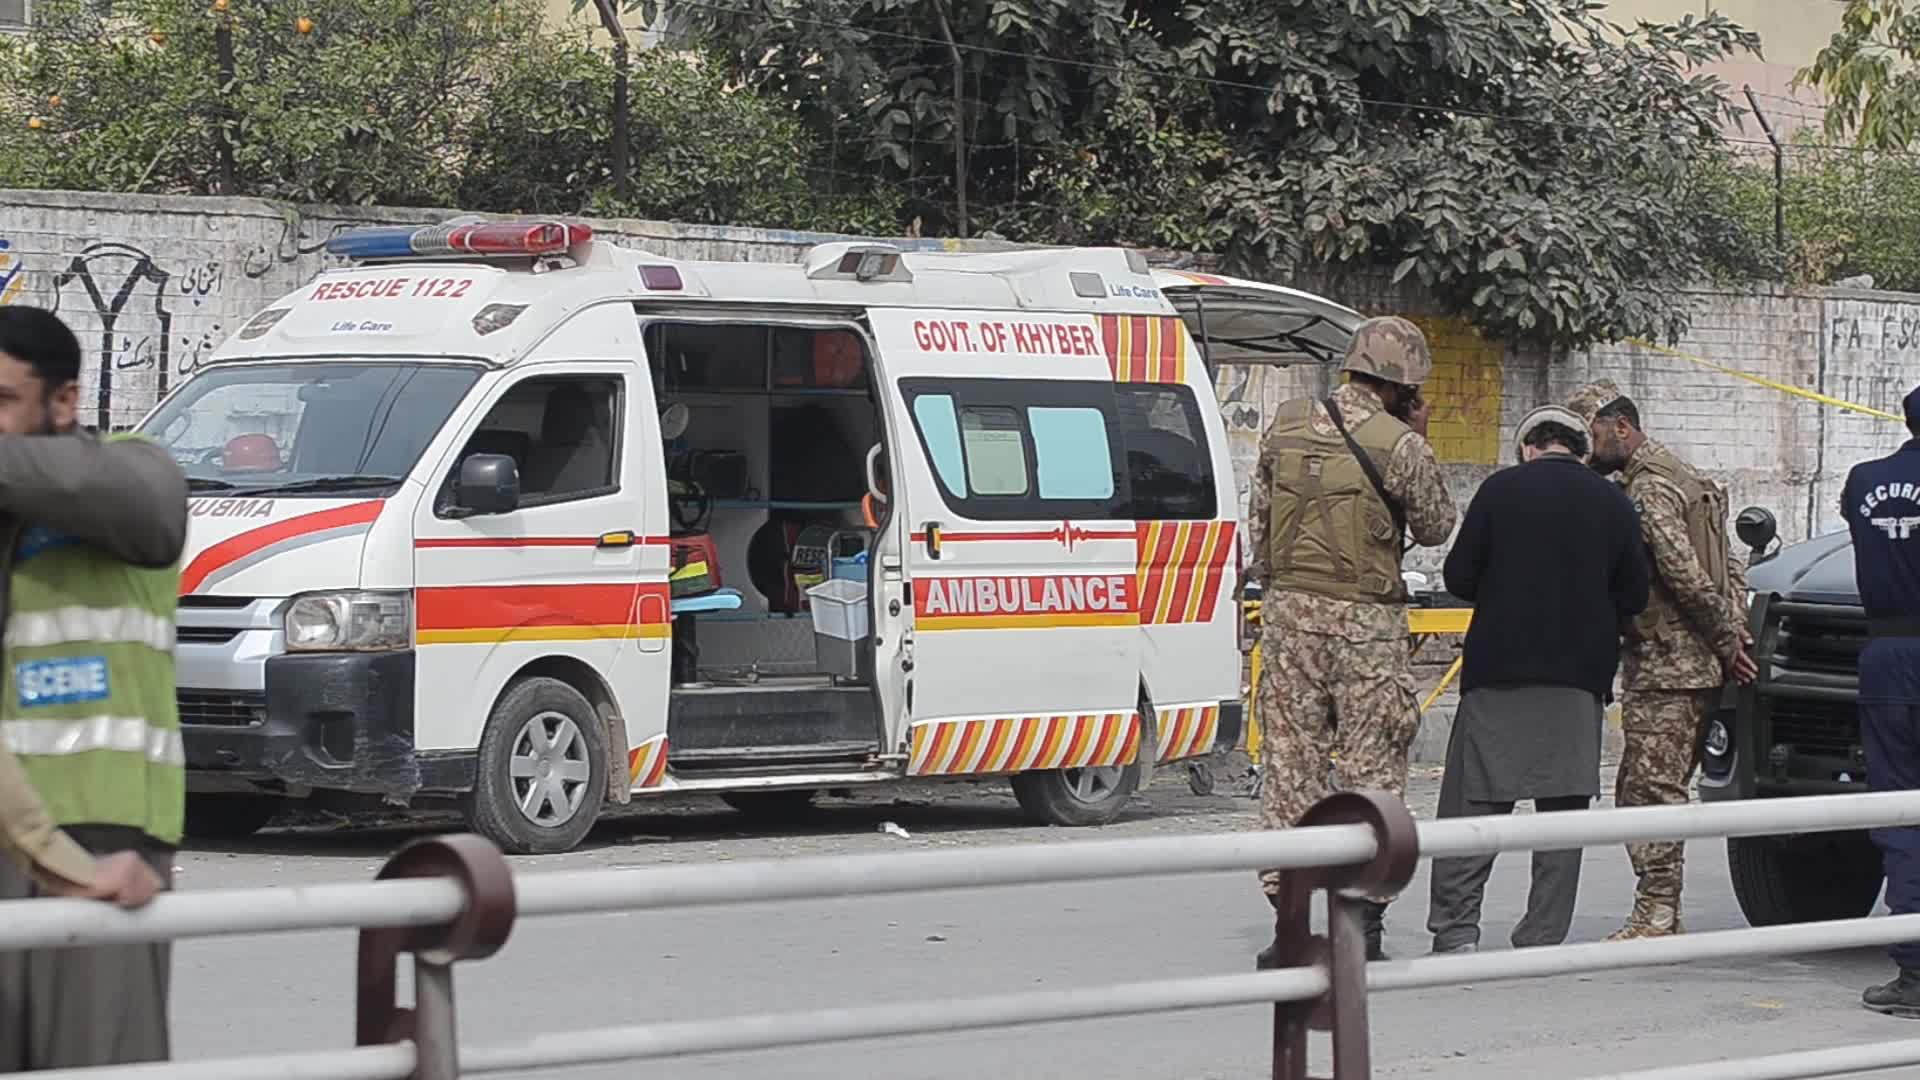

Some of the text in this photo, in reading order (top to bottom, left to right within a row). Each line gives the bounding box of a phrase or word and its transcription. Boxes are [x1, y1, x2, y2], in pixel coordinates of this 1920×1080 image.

[309, 278, 472, 301] RESCUE 1122
[1110, 283, 1158, 299] Life Care
[331, 320, 392, 332] Life Care
[914, 319, 1100, 355] GOVT. OF KHYBER
[1859, 482, 1920, 517] SECURI
[925, 576, 1128, 614] AMBULANCE
[20, 663, 105, 700] SCENE
